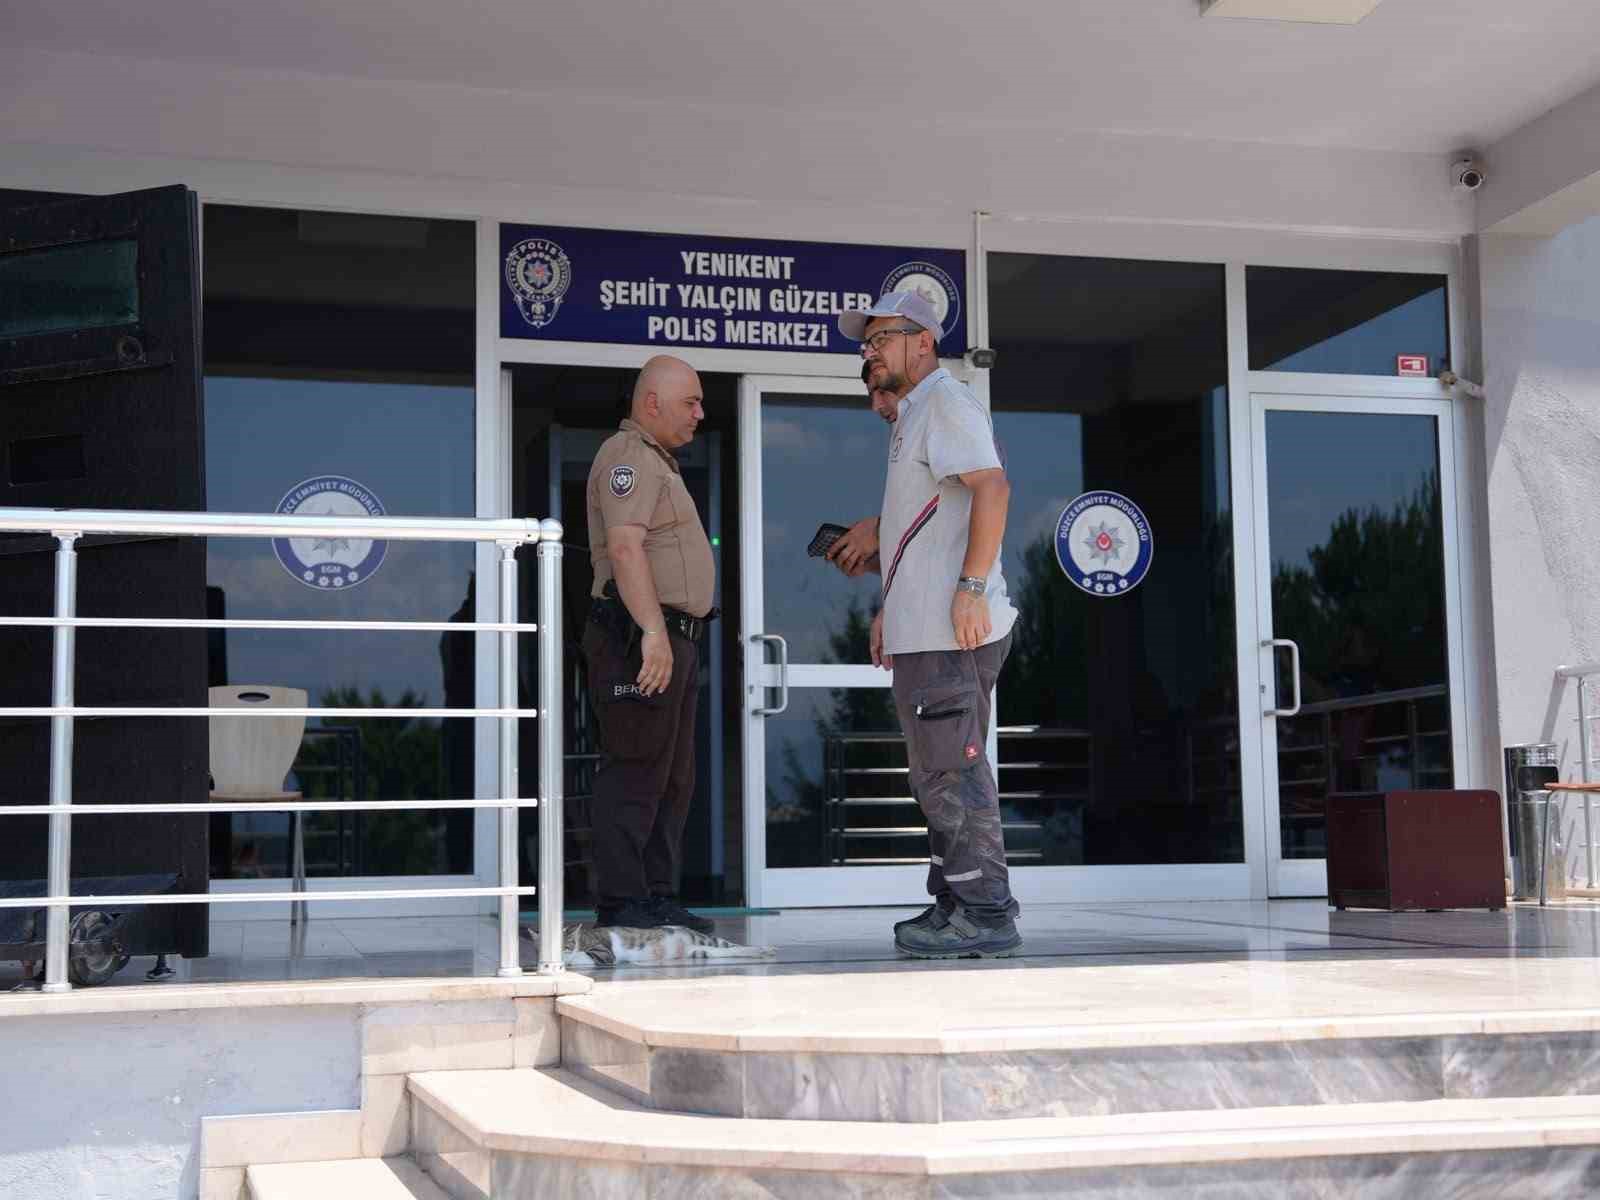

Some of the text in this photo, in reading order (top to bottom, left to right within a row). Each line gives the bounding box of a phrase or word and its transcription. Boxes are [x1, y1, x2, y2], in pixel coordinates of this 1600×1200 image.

[600, 277, 671, 310] ŞEHİT
[677, 284, 761, 316] YALÇIN
[769, 285, 873, 315] GÜZELER
[614, 684, 640, 696] BEK
